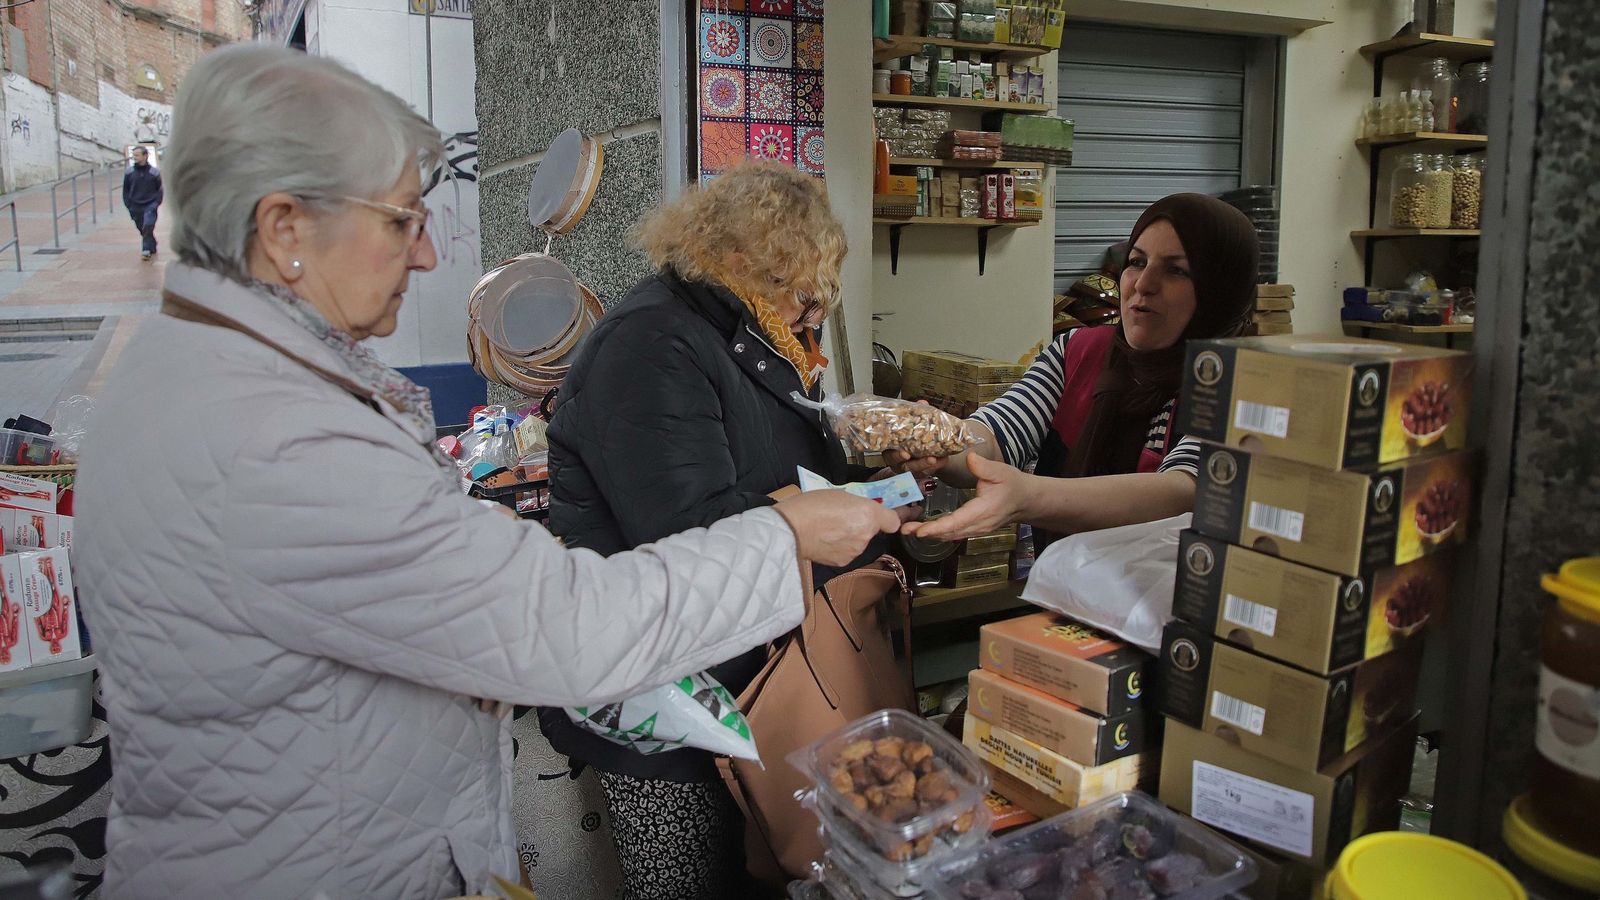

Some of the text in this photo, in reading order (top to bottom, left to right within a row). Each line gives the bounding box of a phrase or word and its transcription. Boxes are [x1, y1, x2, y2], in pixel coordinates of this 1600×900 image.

[980, 736, 1003, 752] DEGLET
[1004, 750, 1022, 764] NOUR
[1025, 762, 1033, 770] DE
[1036, 767, 1062, 785] TUNISIE
[989, 735, 1011, 750] DATTES
[1013, 749, 1053, 773] NATURELLES
